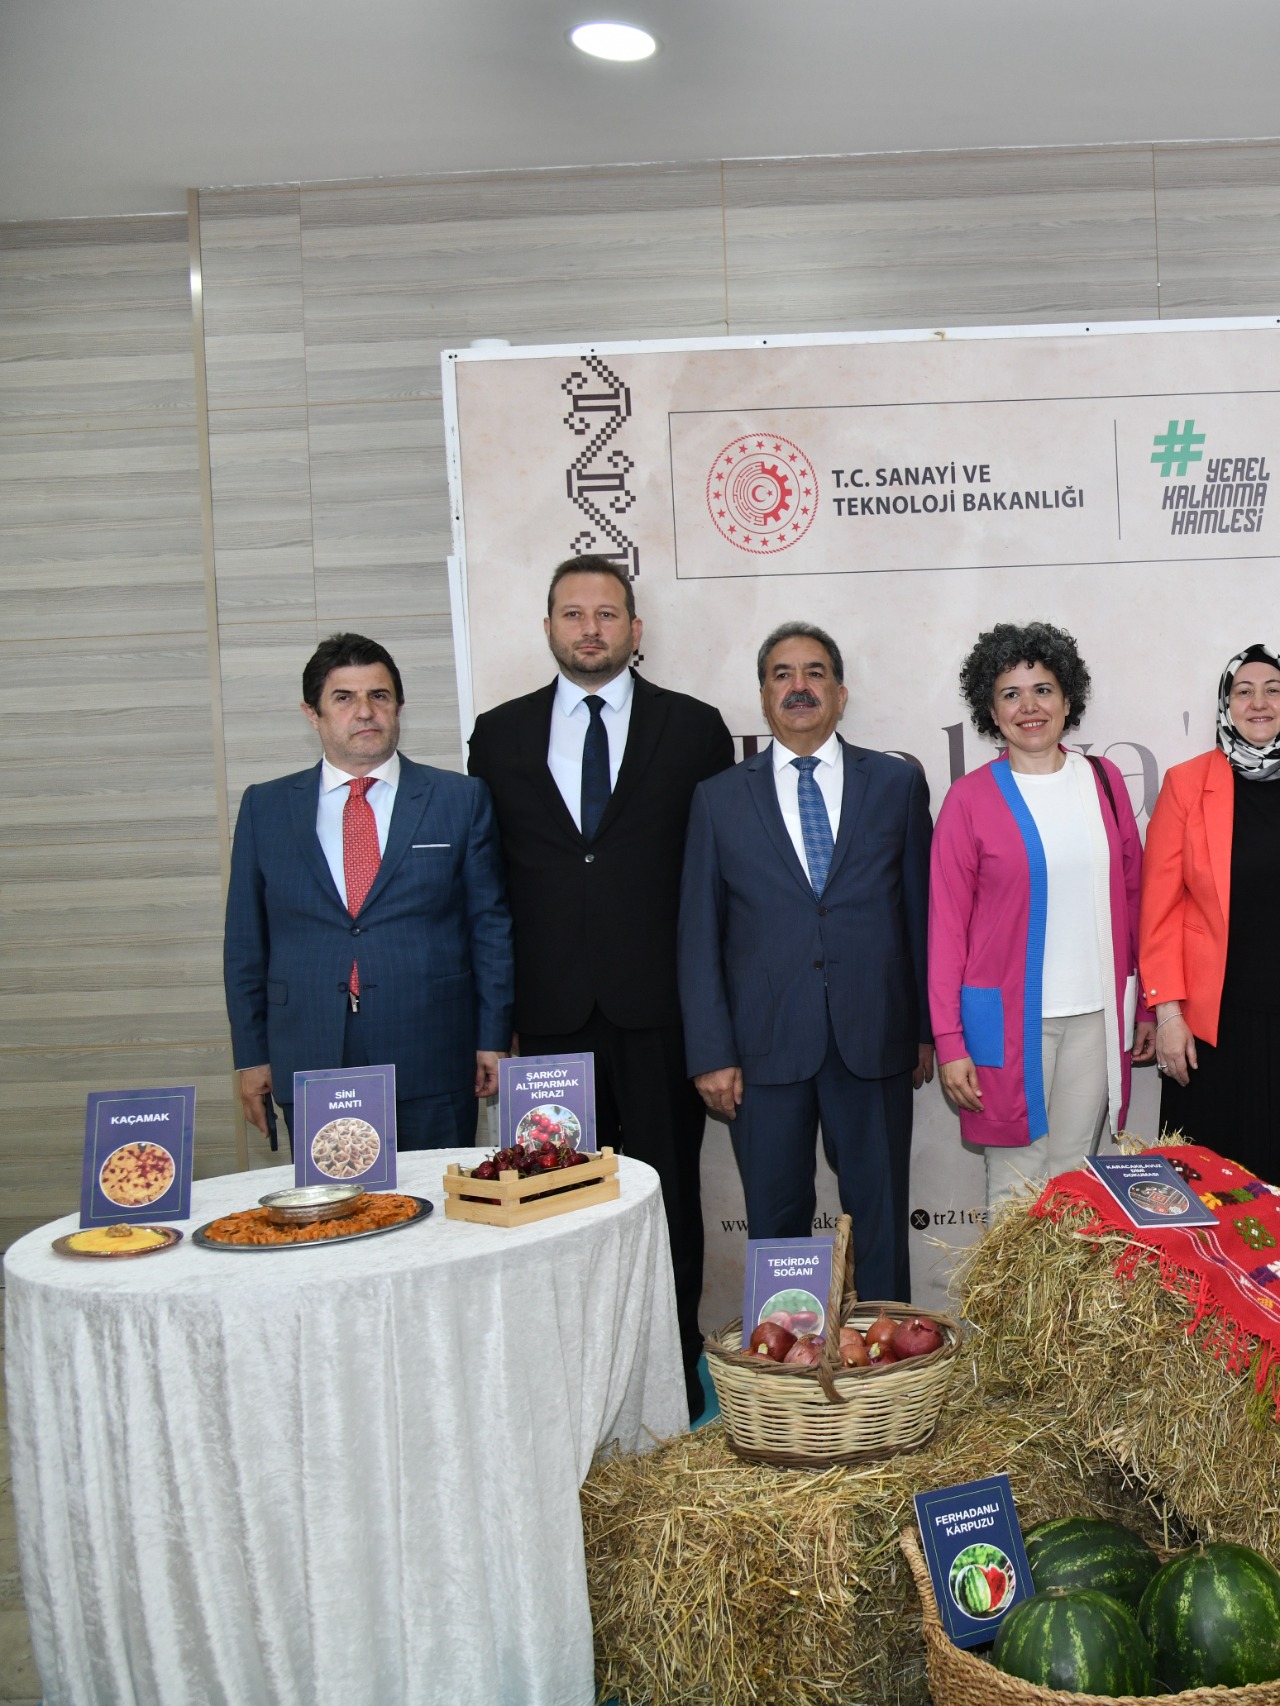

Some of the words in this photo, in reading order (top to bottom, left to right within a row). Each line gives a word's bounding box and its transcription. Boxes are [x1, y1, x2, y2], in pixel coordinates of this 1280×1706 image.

[832, 469, 870, 488] T.C.
[875, 461, 956, 487] SANAYİ
[962, 464, 991, 484] VE
[1206, 457, 1270, 483] YEREL
[832, 490, 956, 517] TEKNOLOJİ
[962, 485, 1085, 512] BAKANLIĞI
[1162, 482, 1268, 510] KALKINMA
[1171, 508, 1264, 535] HAMLESİ
[526, 1069, 568, 1081] ŞARKÖY
[516, 1079, 579, 1090] ALTIPARMAK
[334, 1088, 357, 1100] SİNİ
[531, 1089, 564, 1099] KİRAZI
[328, 1099, 363, 1110] MANTI
[111, 1112, 170, 1126] KAÇAMAK
[768, 1256, 819, 1267] TEKİRDAĞ
[774, 1267, 813, 1276] SOĞANI
[935, 1502, 1000, 1526] FERHADANLI
[946, 1517, 994, 1537] KARPUZU
